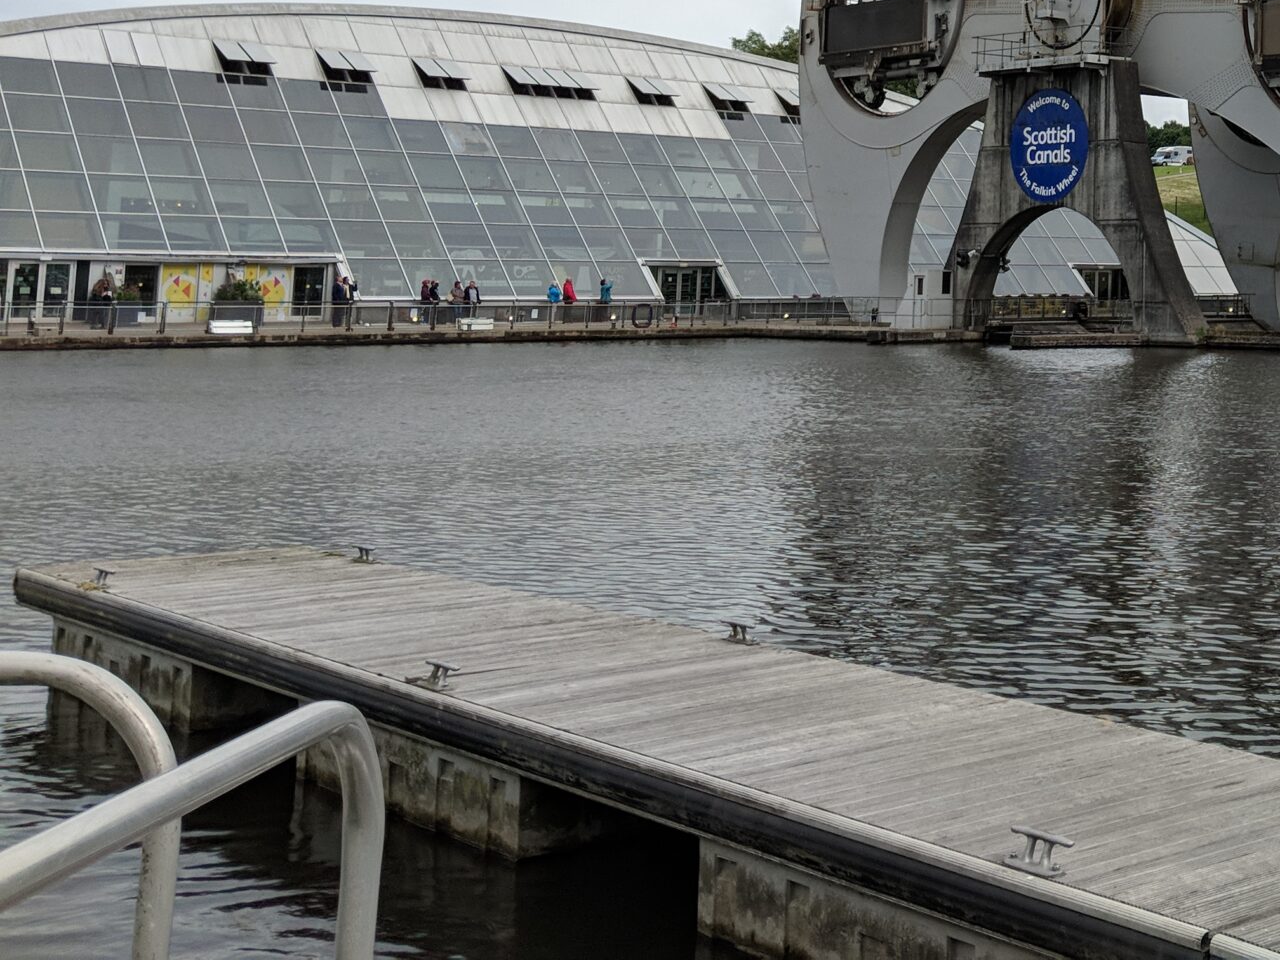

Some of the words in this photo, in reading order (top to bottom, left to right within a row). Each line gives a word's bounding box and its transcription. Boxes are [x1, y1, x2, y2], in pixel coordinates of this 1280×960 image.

[1027, 96, 1061, 113] Welcome
[1061, 98, 1070, 110] to
[1023, 124, 1075, 146] Scottish
[1026, 144, 1071, 165] Canals
[1019, 168, 1031, 188] The
[1030, 182, 1057, 196] Falkirk
[1056, 165, 1079, 192] Wheel
